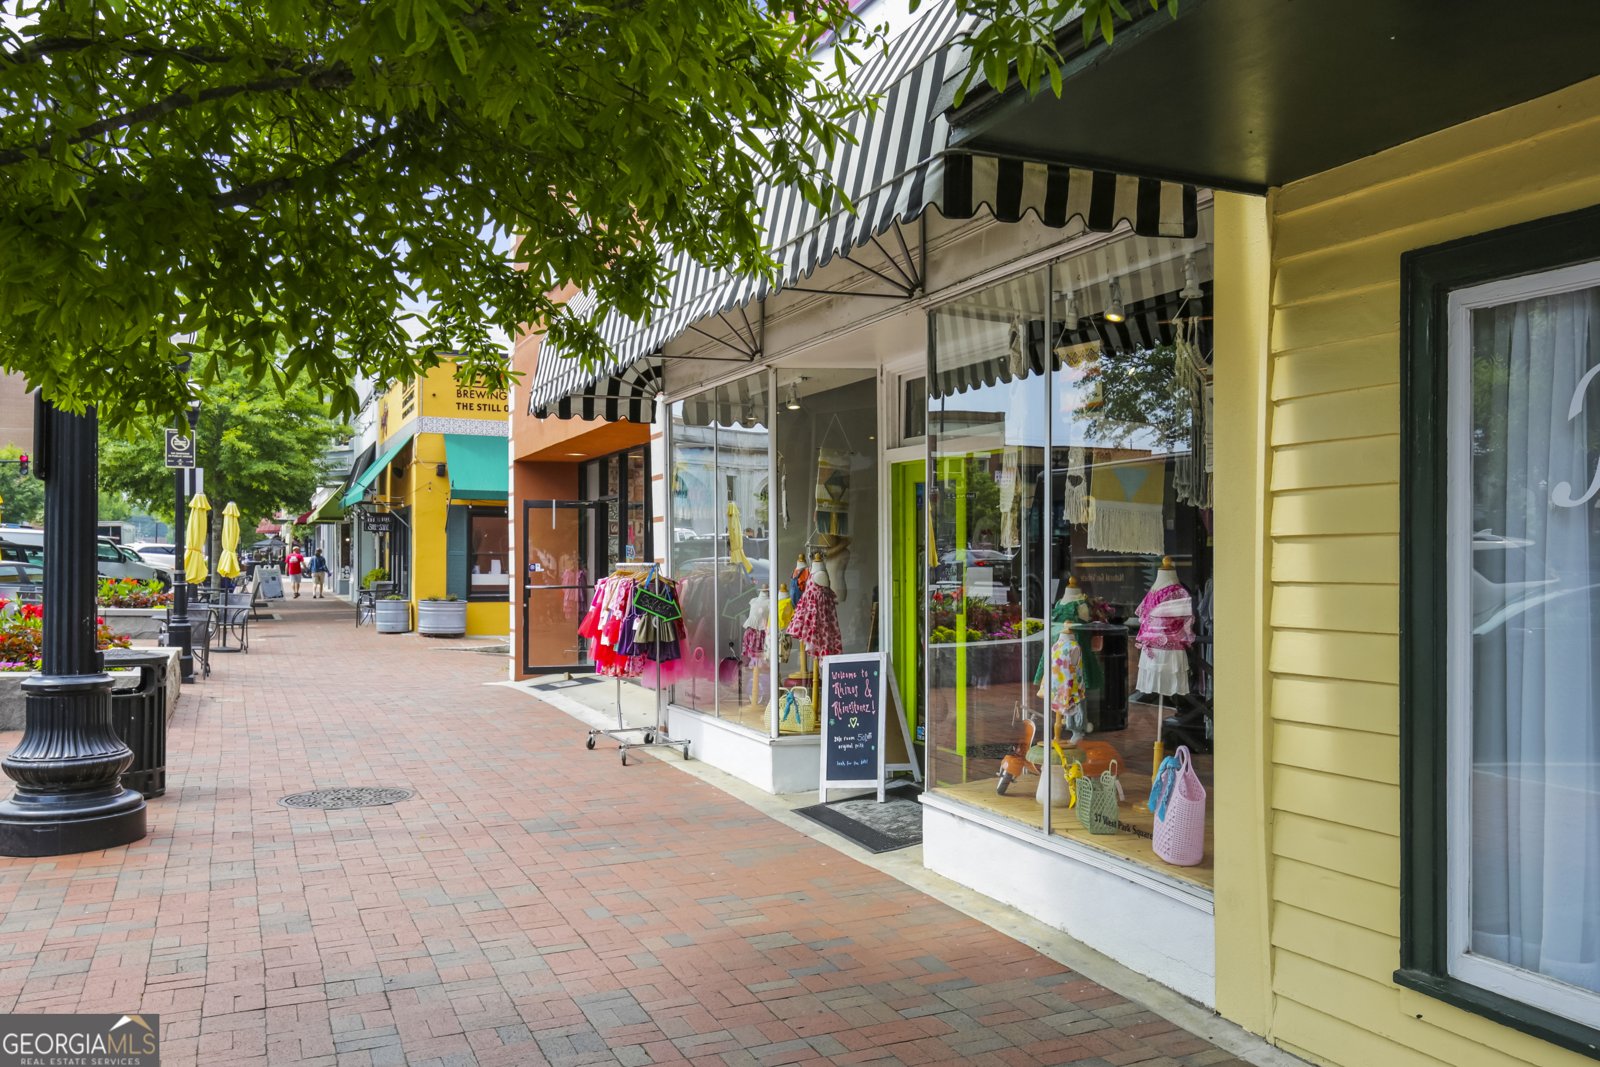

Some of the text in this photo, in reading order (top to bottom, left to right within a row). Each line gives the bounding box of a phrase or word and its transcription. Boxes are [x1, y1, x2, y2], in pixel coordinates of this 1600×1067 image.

[456, 402, 474, 411] THE
[477, 403, 501, 412] STILL
[831, 668, 868, 680] Welcome to
[864, 678, 873, 698] &
[1102, 815, 1117, 828] West
[1117, 820, 1131, 833] Park
